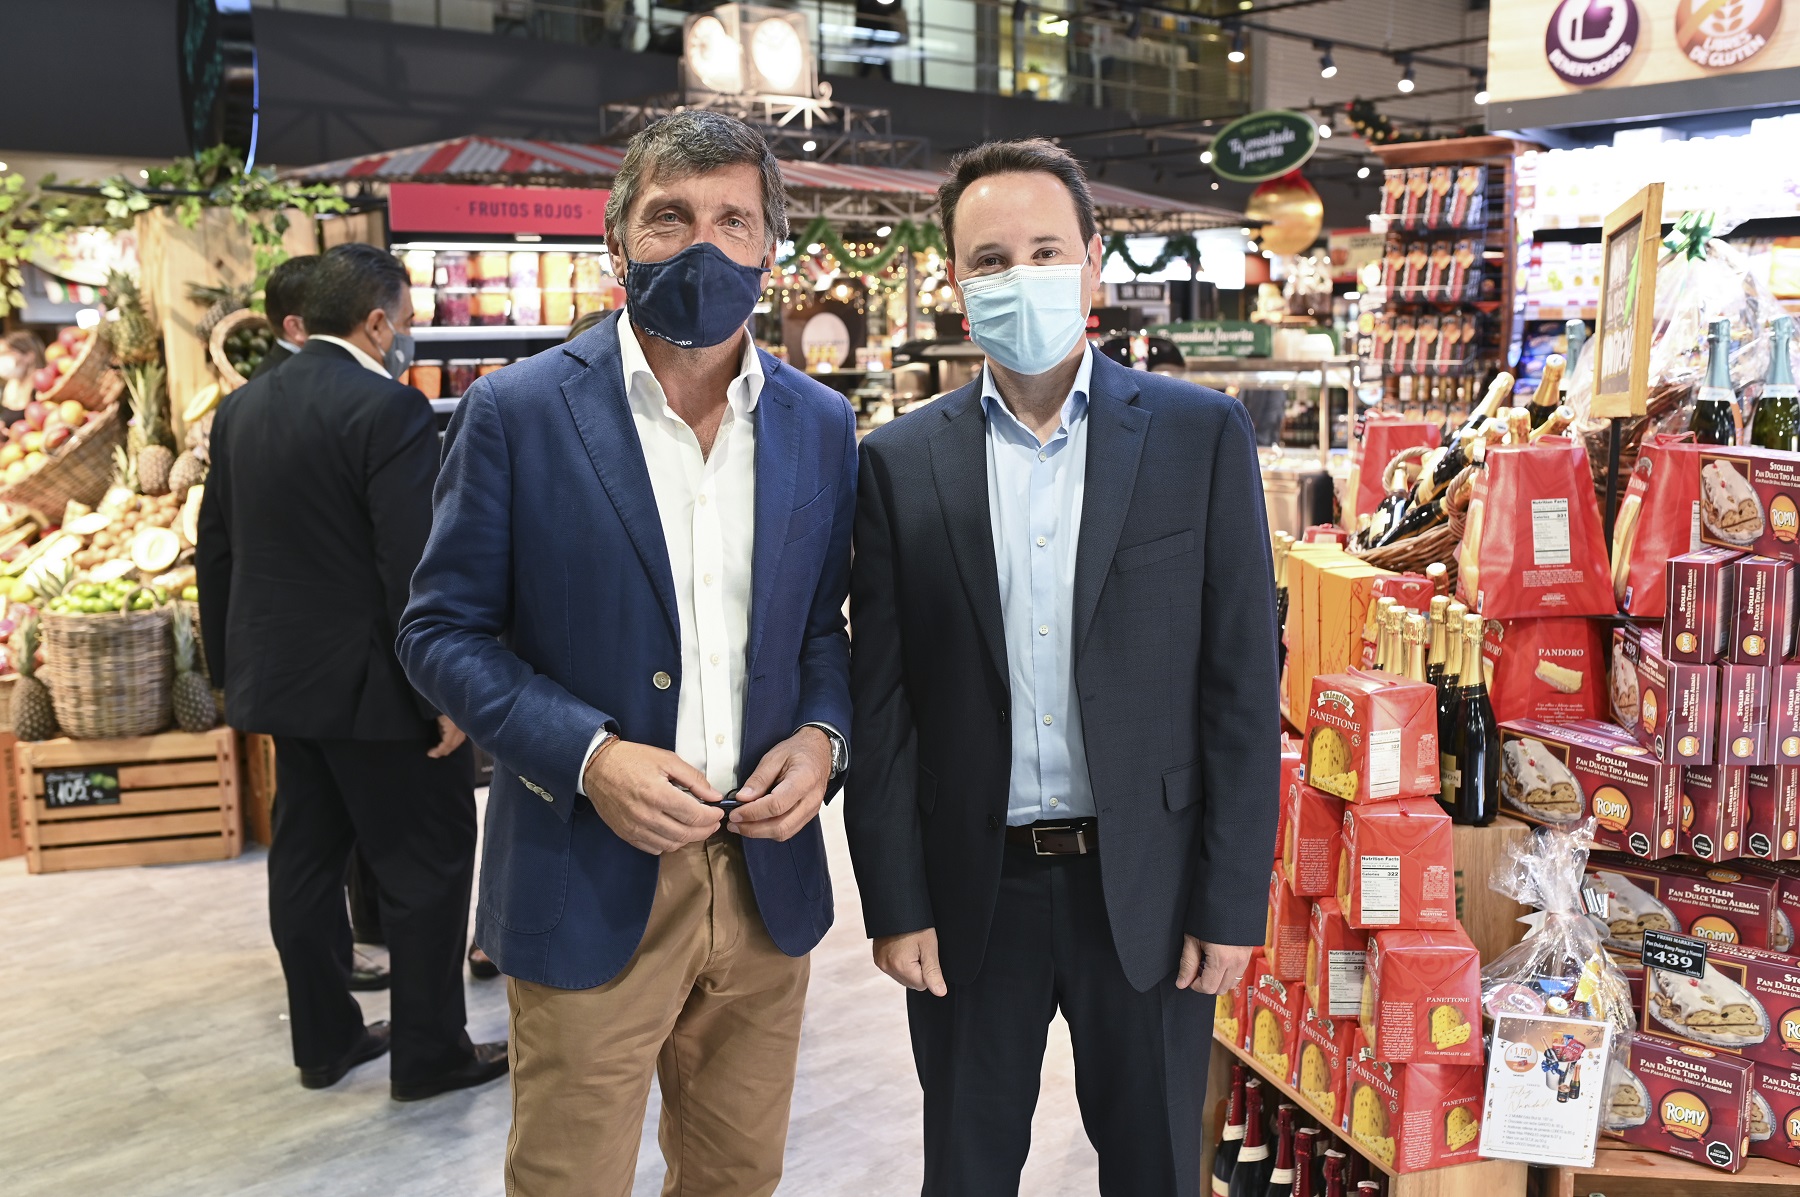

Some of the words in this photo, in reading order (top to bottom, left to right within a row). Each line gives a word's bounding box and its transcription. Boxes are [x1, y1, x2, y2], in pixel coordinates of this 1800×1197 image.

[1549, 42, 1632, 77] BENEFICIOSOS
[1708, 35, 1766, 67] GLUTEN
[469, 201, 528, 217] FRUTOS
[534, 203, 582, 219] ROJOS
[1769, 462, 1794, 472] STOLLEN
[1771, 509, 1796, 528] ROMY
[1538, 648, 1584, 657] PANDORO
[1322, 690, 1350, 707] Valentino
[1310, 708, 1361, 733] PANETTONE
[1575, 757, 1588, 767] PAN
[1588, 759, 1608, 772] DULCE
[1608, 765, 1623, 776] TIPO
[1623, 769, 1649, 782] ALEMÁN
[1595, 753, 1628, 769] STOLLEN
[1686, 770, 1713, 783] ALEMÁN
[1595, 797, 1628, 820] ROMY
[1668, 888, 1684, 898] PAN
[1684, 890, 1709, 902] DULCE
[1709, 895, 1728, 905] TIPO
[1728, 899, 1760, 911] ALEMÁN
[1693, 883, 1734, 898] STOLLEN
[1782, 891, 1799, 902] PAN
[1653, 950, 1693, 969] 439
[1756, 977, 1773, 987] PAN
[1253, 987, 1292, 1020] PANETTONE
[1300, 1021, 1339, 1056] PANETTONE
[1639, 1058, 1656, 1069] PAN
[1656, 1062, 1681, 1075] DULCE
[1682, 1068, 1700, 1081] TIPO
[1701, 1072, 1733, 1089] ALEMÁN
[1665, 1056, 1707, 1074] STOLLEN
[1352, 1061, 1399, 1100] PANETTONE
[1650, 1069, 1664, 1078] PASAS
[1684, 1076, 1701, 1086] NUECES
[1705, 1083, 1732, 1095] ALMENDRAS
[1762, 1075, 1779, 1087] PAN
[1442, 1095, 1477, 1107] PANETTONE
[1664, 1102, 1706, 1127] ROMY
[1666, 1125, 1684, 1134] Desde
[1684, 1127, 1700, 1139] 1960
[1294, 1162, 1302, 1196] CHANDON
